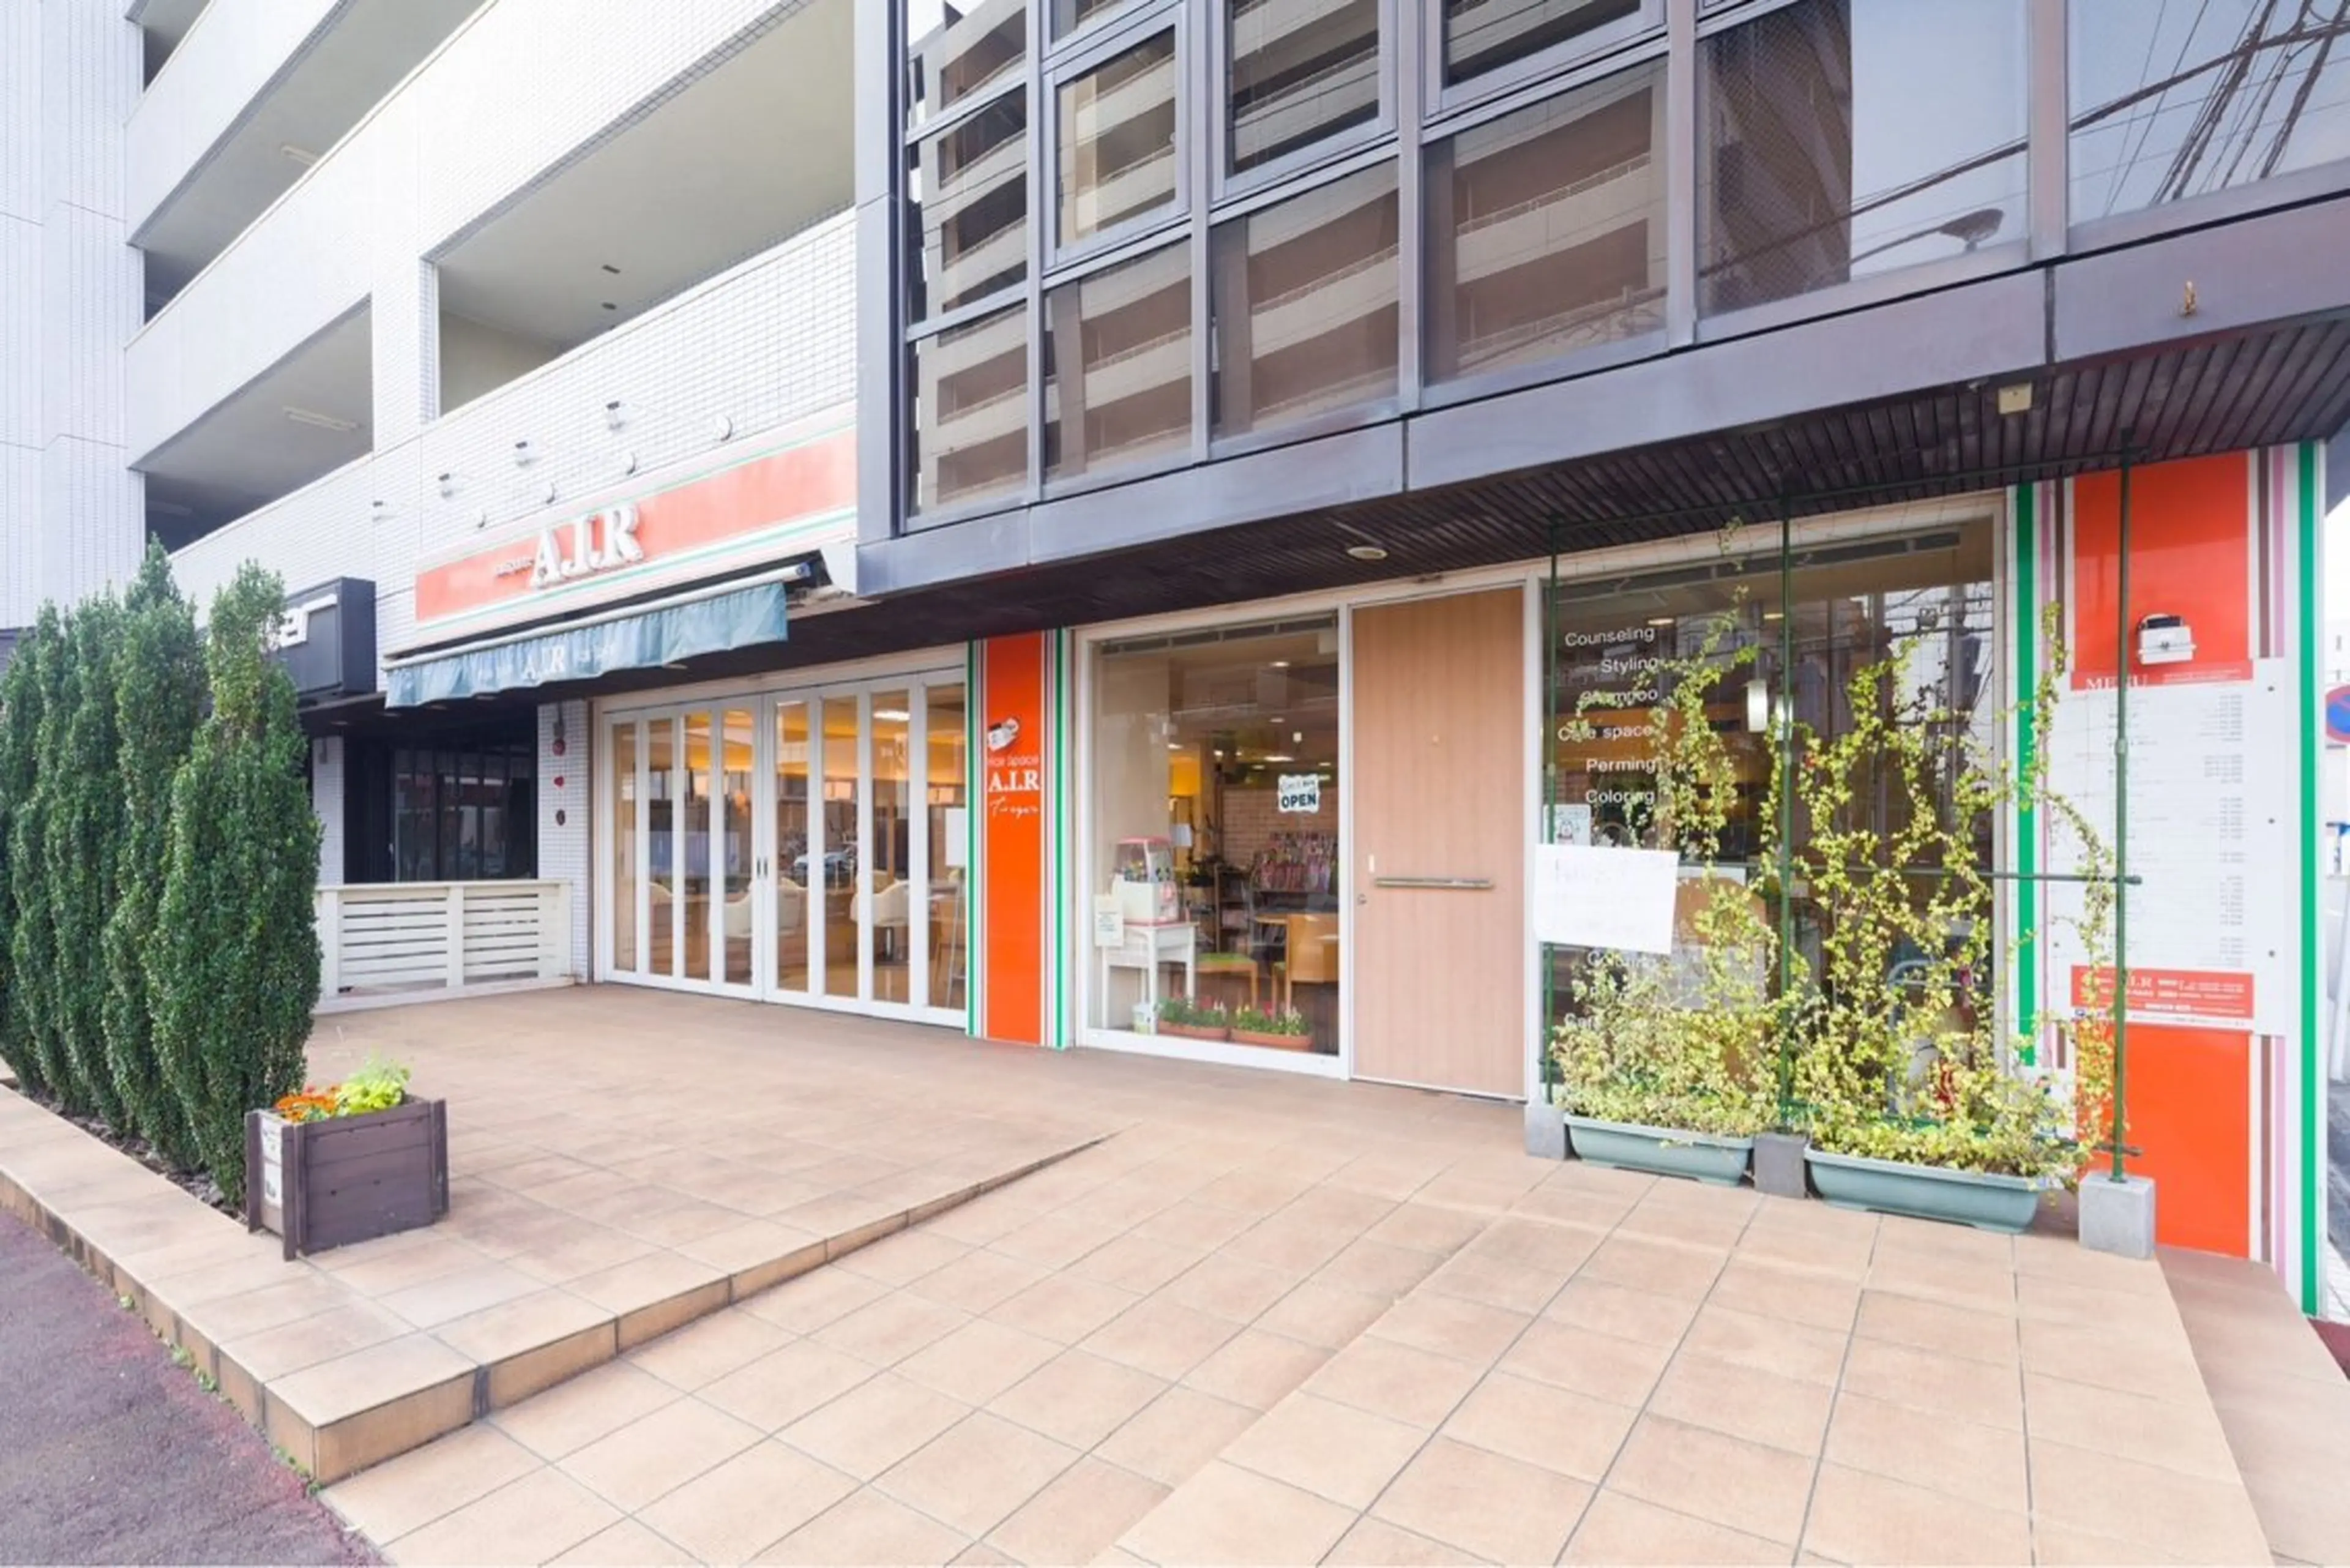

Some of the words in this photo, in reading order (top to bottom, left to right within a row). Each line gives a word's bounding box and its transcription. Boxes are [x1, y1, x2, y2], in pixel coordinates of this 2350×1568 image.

[1565, 627, 1655, 646] Counseling
[1601, 657, 1658, 674] Styling
[1580, 689, 1658, 706] Smpoo
[1558, 723, 1597, 741] Ce
[1603, 725, 1654, 741] space
[1586, 757, 1655, 774] Perming
[988, 770, 1039, 793] A.I.R
[1281, 793, 1316, 808] OPEN
[1585, 789, 1655, 805] Colorg
